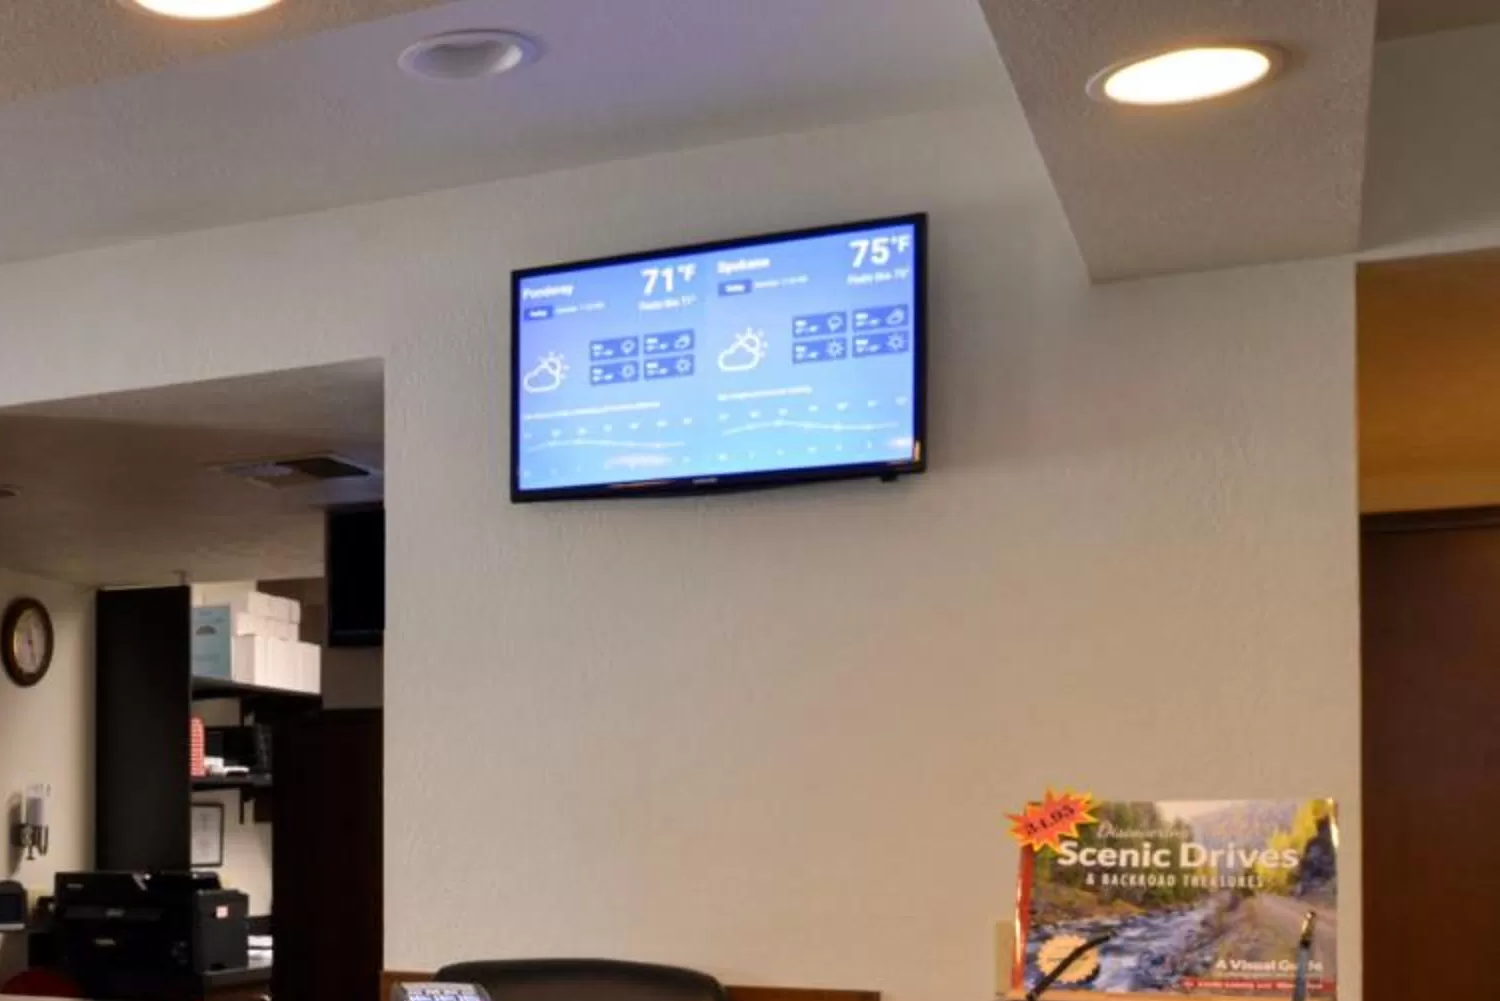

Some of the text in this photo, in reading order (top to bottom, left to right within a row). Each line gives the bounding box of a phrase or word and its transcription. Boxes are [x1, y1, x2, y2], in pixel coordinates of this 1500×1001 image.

[1057, 839, 1299, 869] Scenic Drives
[1102, 874, 1176, 887] BACKROAD
[1216, 960, 1227, 970] A
[1229, 959, 1276, 971] Visual
